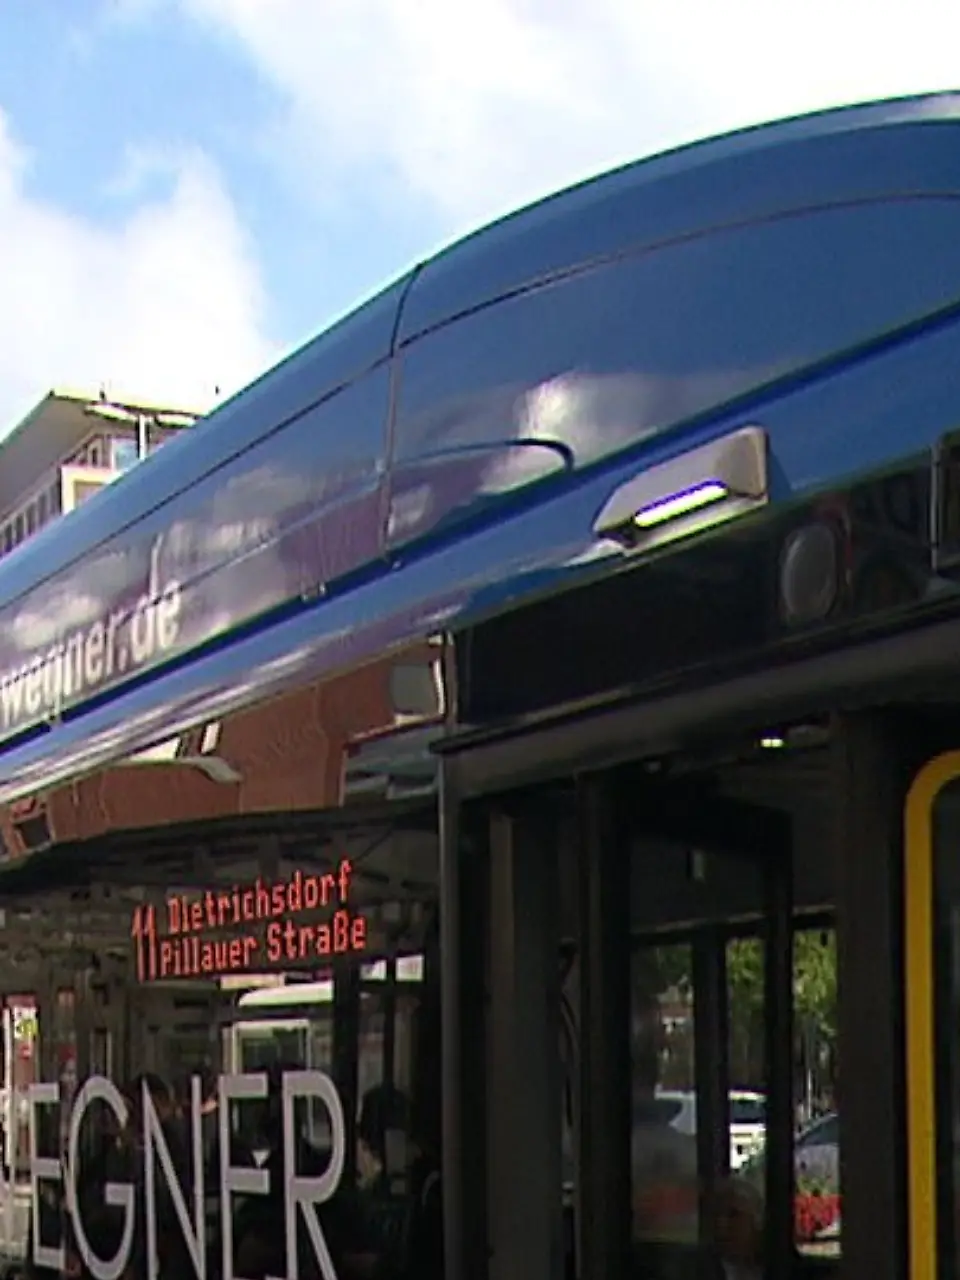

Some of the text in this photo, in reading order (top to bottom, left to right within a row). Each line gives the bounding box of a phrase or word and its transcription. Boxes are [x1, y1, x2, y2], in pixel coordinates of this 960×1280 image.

[131, 859, 352, 983] 11 Dietrichsdorf
[160, 911, 367, 979] Pillauer Straße
